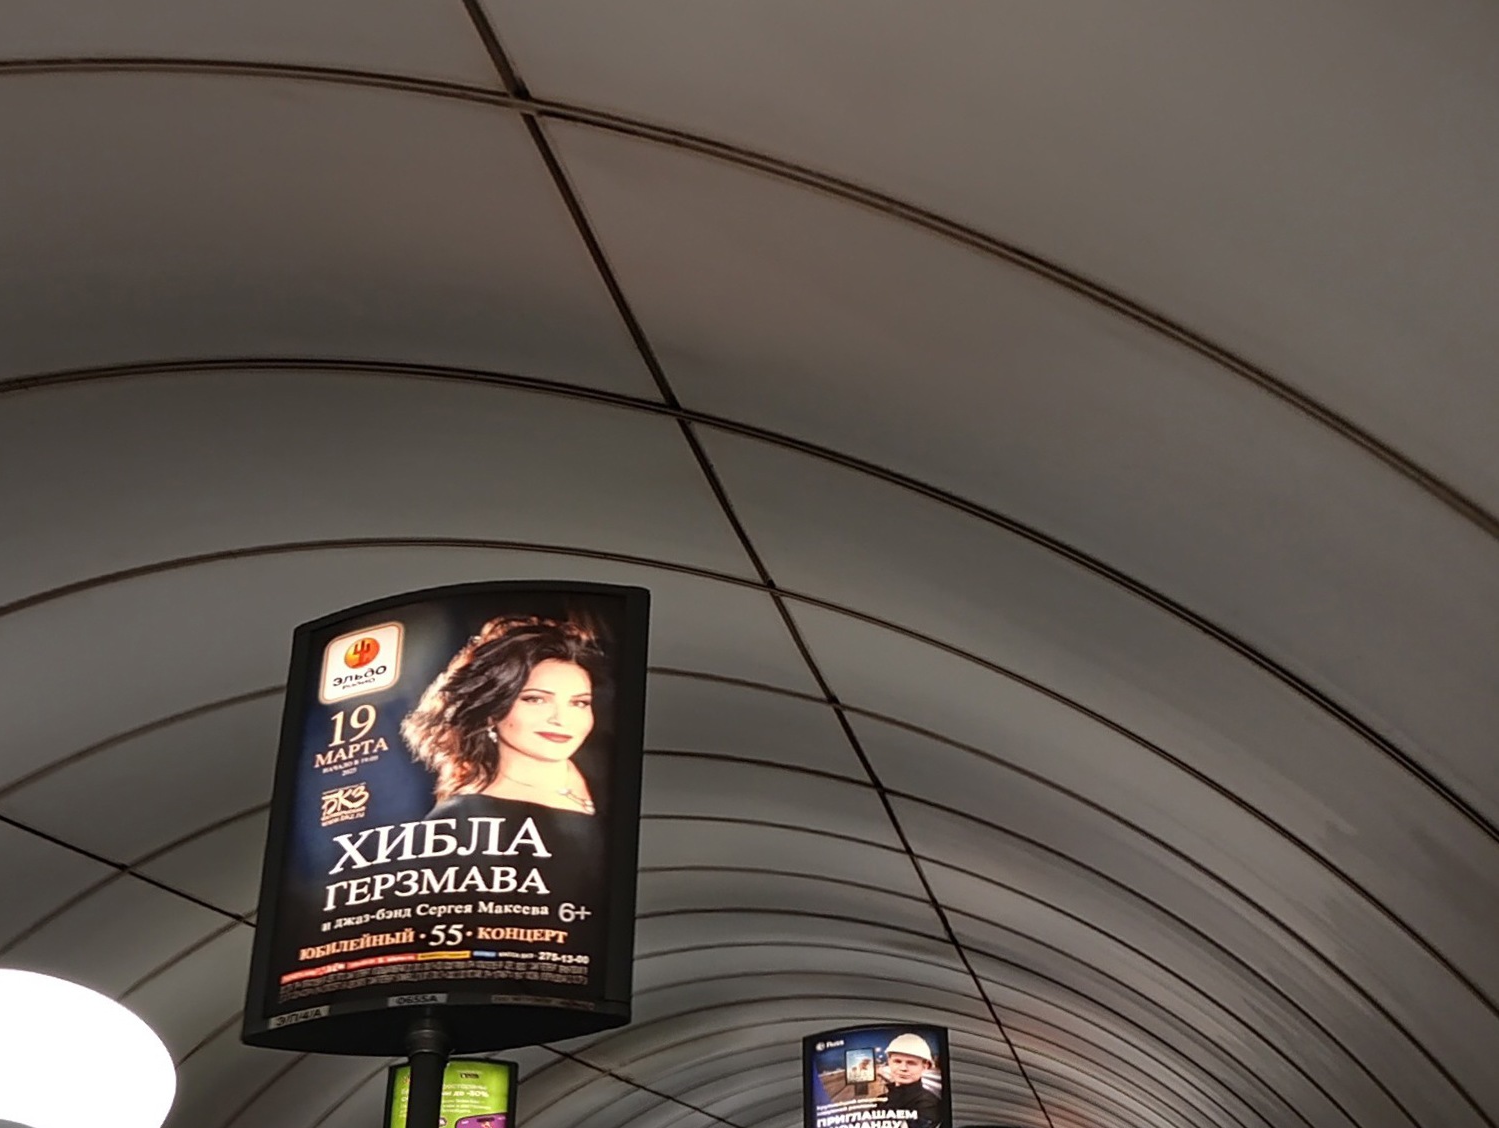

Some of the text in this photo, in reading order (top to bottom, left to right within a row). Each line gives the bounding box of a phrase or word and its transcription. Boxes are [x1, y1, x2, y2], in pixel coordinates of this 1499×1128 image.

[328, 704, 376, 748] 19
[313, 737, 389, 768] МАРТА
[328, 816, 552, 875] ХИБЛА
[322, 866, 551, 911] ГЕРЗМАВА
[322, 900, 550, 933] и джаз-бэнд Сергея Макеева
[558, 902, 592, 923] 6+
[298, 928, 416, 961] ЮБИЛЕЙНЫЙ
[477, 926, 569, 945] КОНЦЕРТ
[817, 1109, 918, 1128] ПРИГЛАШАЕМ
